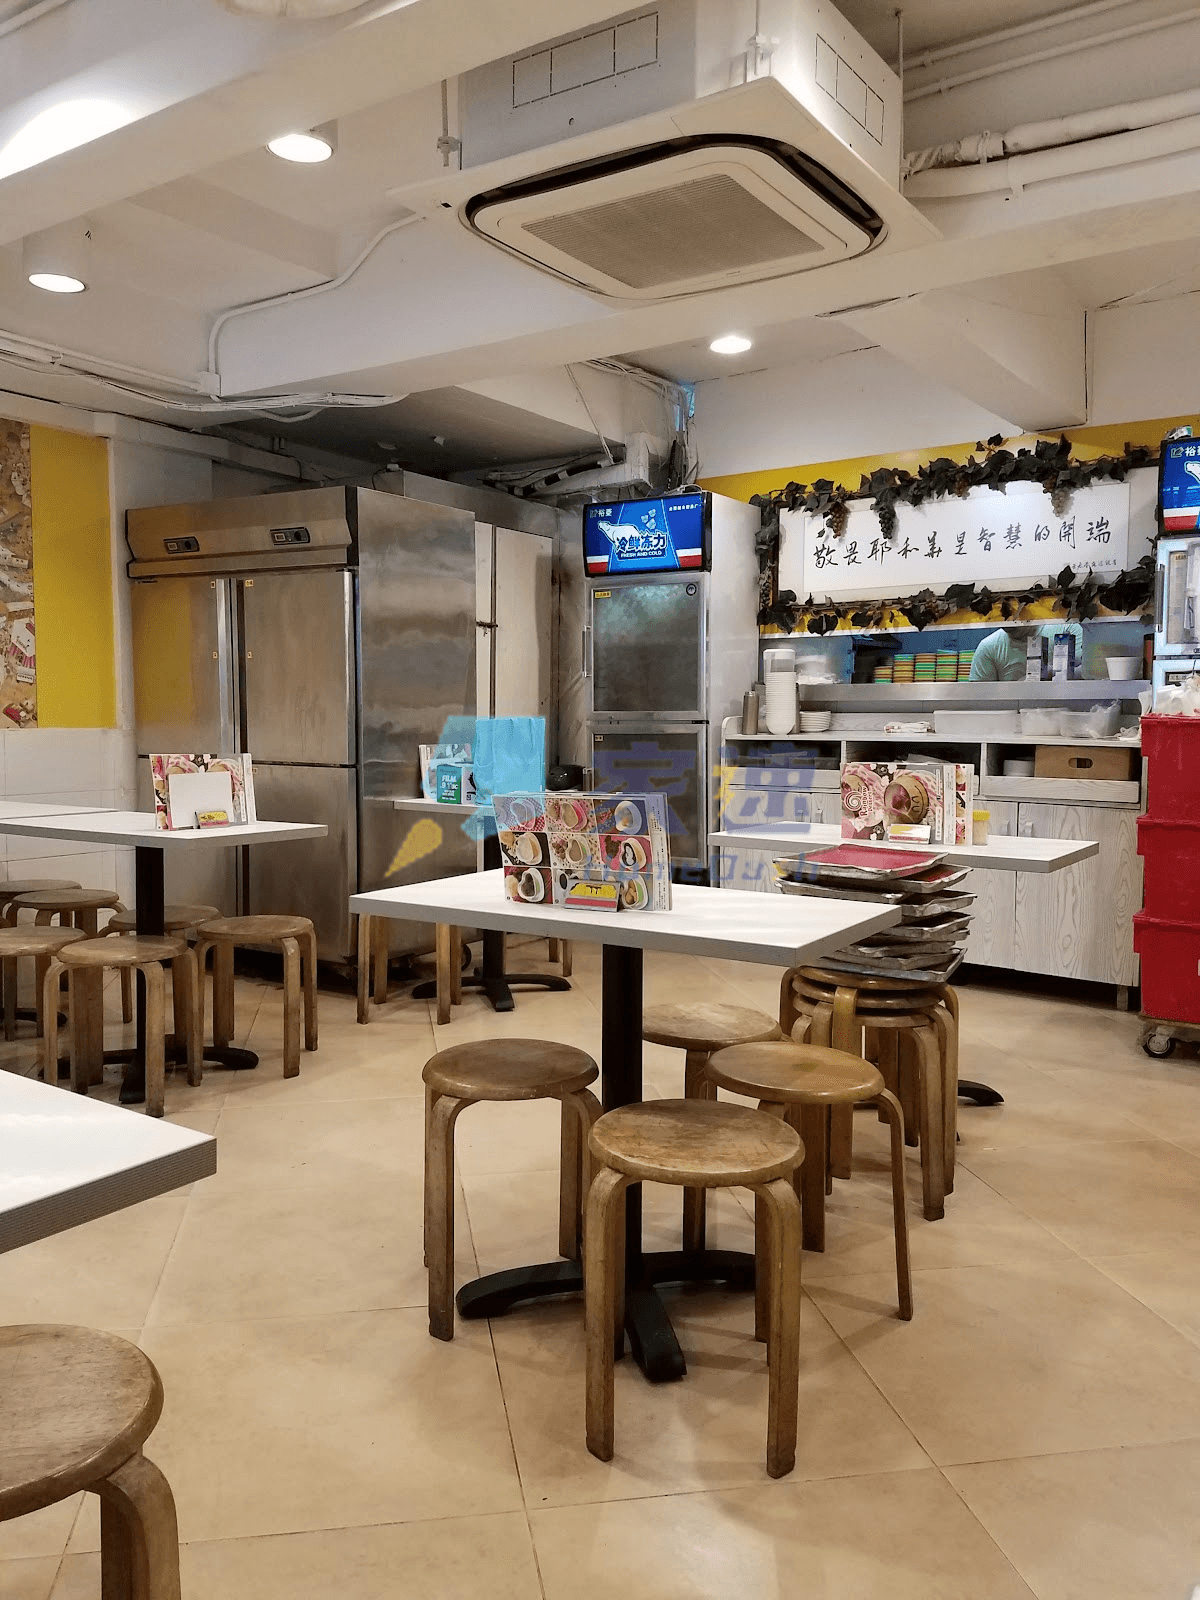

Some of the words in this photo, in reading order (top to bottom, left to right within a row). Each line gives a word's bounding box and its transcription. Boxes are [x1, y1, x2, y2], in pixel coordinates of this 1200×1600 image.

[616, 533, 666, 551] 冷鲜冻力
[859, 786, 868, 817] Rainbow
